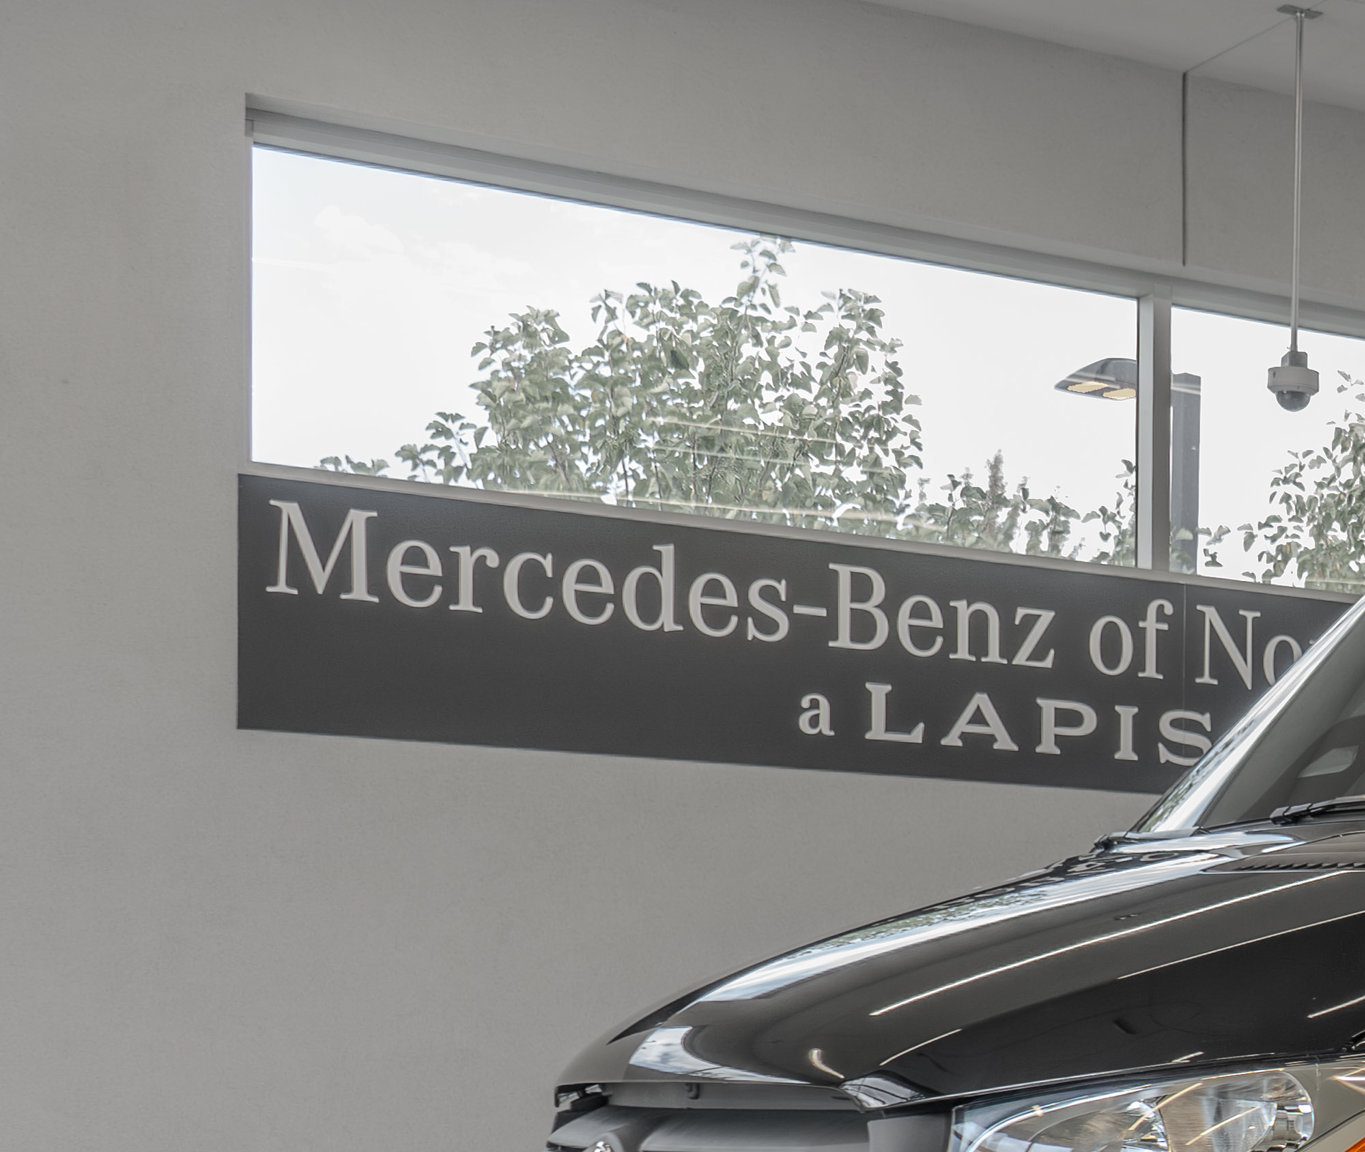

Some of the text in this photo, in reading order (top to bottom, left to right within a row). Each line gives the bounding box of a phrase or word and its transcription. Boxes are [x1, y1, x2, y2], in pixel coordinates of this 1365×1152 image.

[266, 499, 1056, 669] Mercedes-Benz
[1089, 599, 1174, 680] of
[798, 692, 835, 737] a
